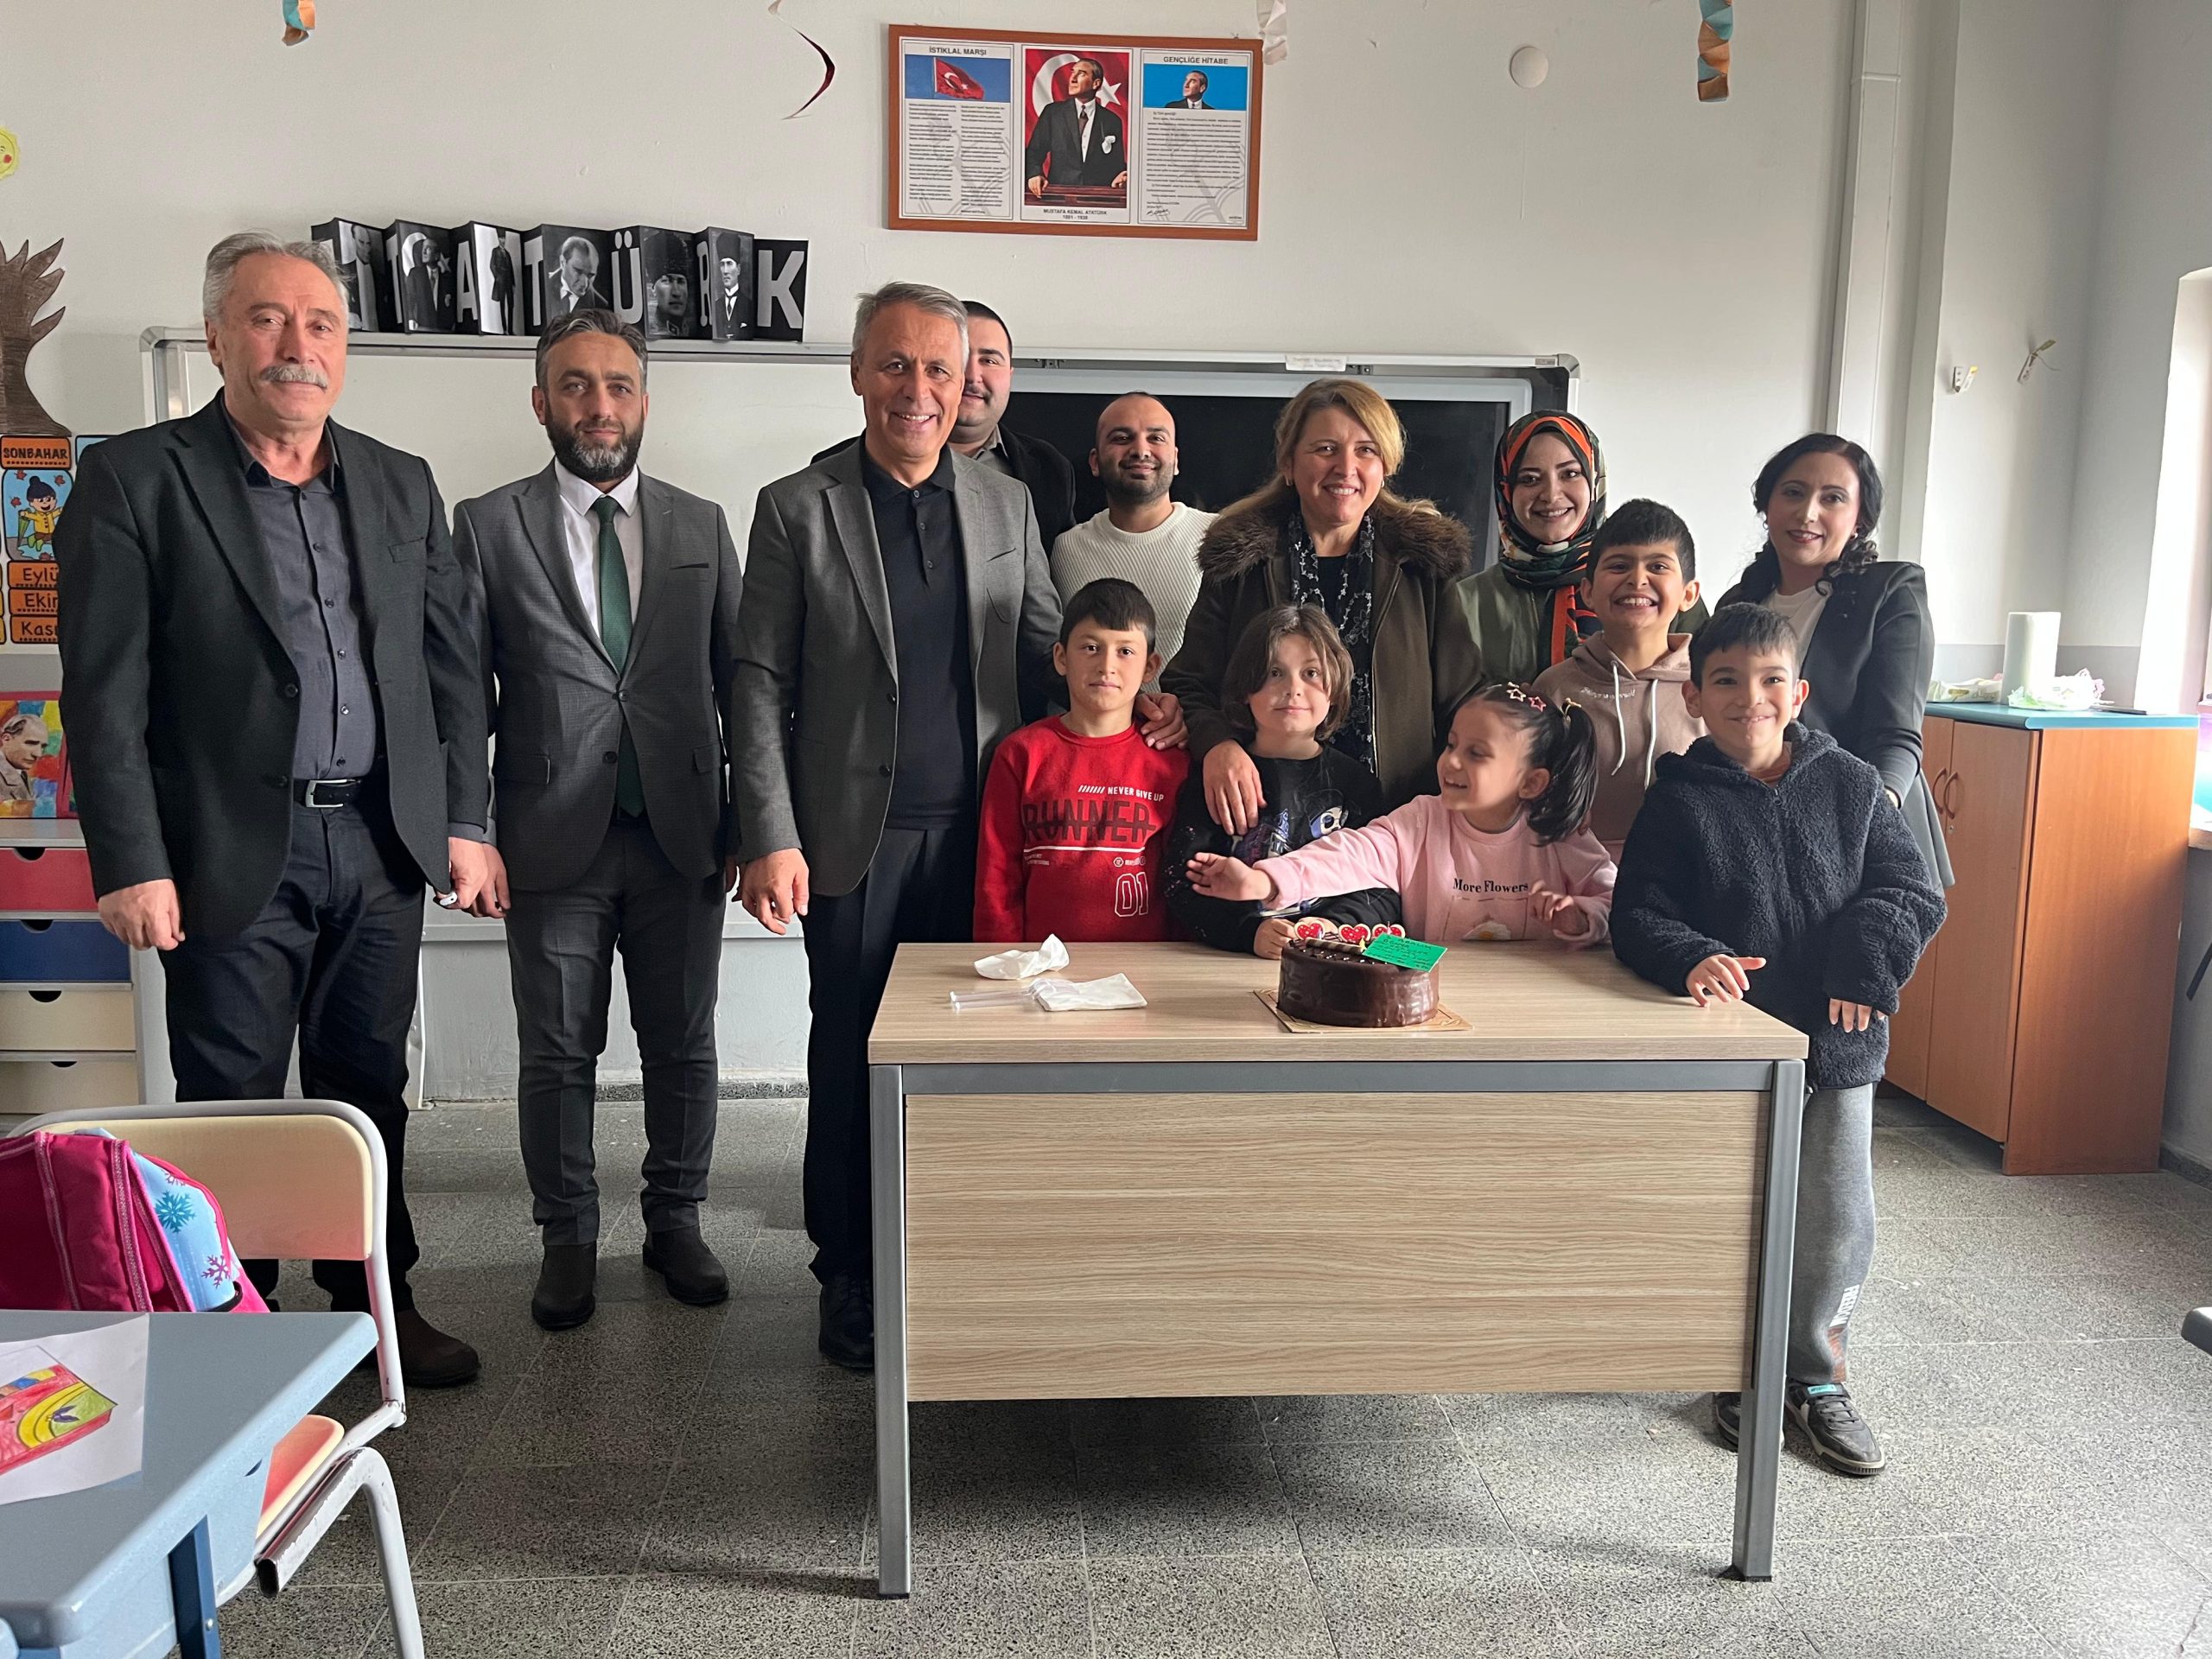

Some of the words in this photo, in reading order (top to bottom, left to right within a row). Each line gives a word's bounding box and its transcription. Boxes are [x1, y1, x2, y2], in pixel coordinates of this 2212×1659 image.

[1202, 56, 1229, 65] HİTABE
[3, 448, 68, 459] SONBAHAR
[22, 567, 59, 587] Eylü
[1107, 786, 1135, 796] NEVER
[1135, 789, 1152, 800] GIVE
[1153, 793, 1165, 802] UP
[1023, 798, 1156, 843] RUNNER
[1452, 877, 1482, 893] More
[1484, 880, 1529, 893] Flowers
[1114, 871, 1149, 918] 01
